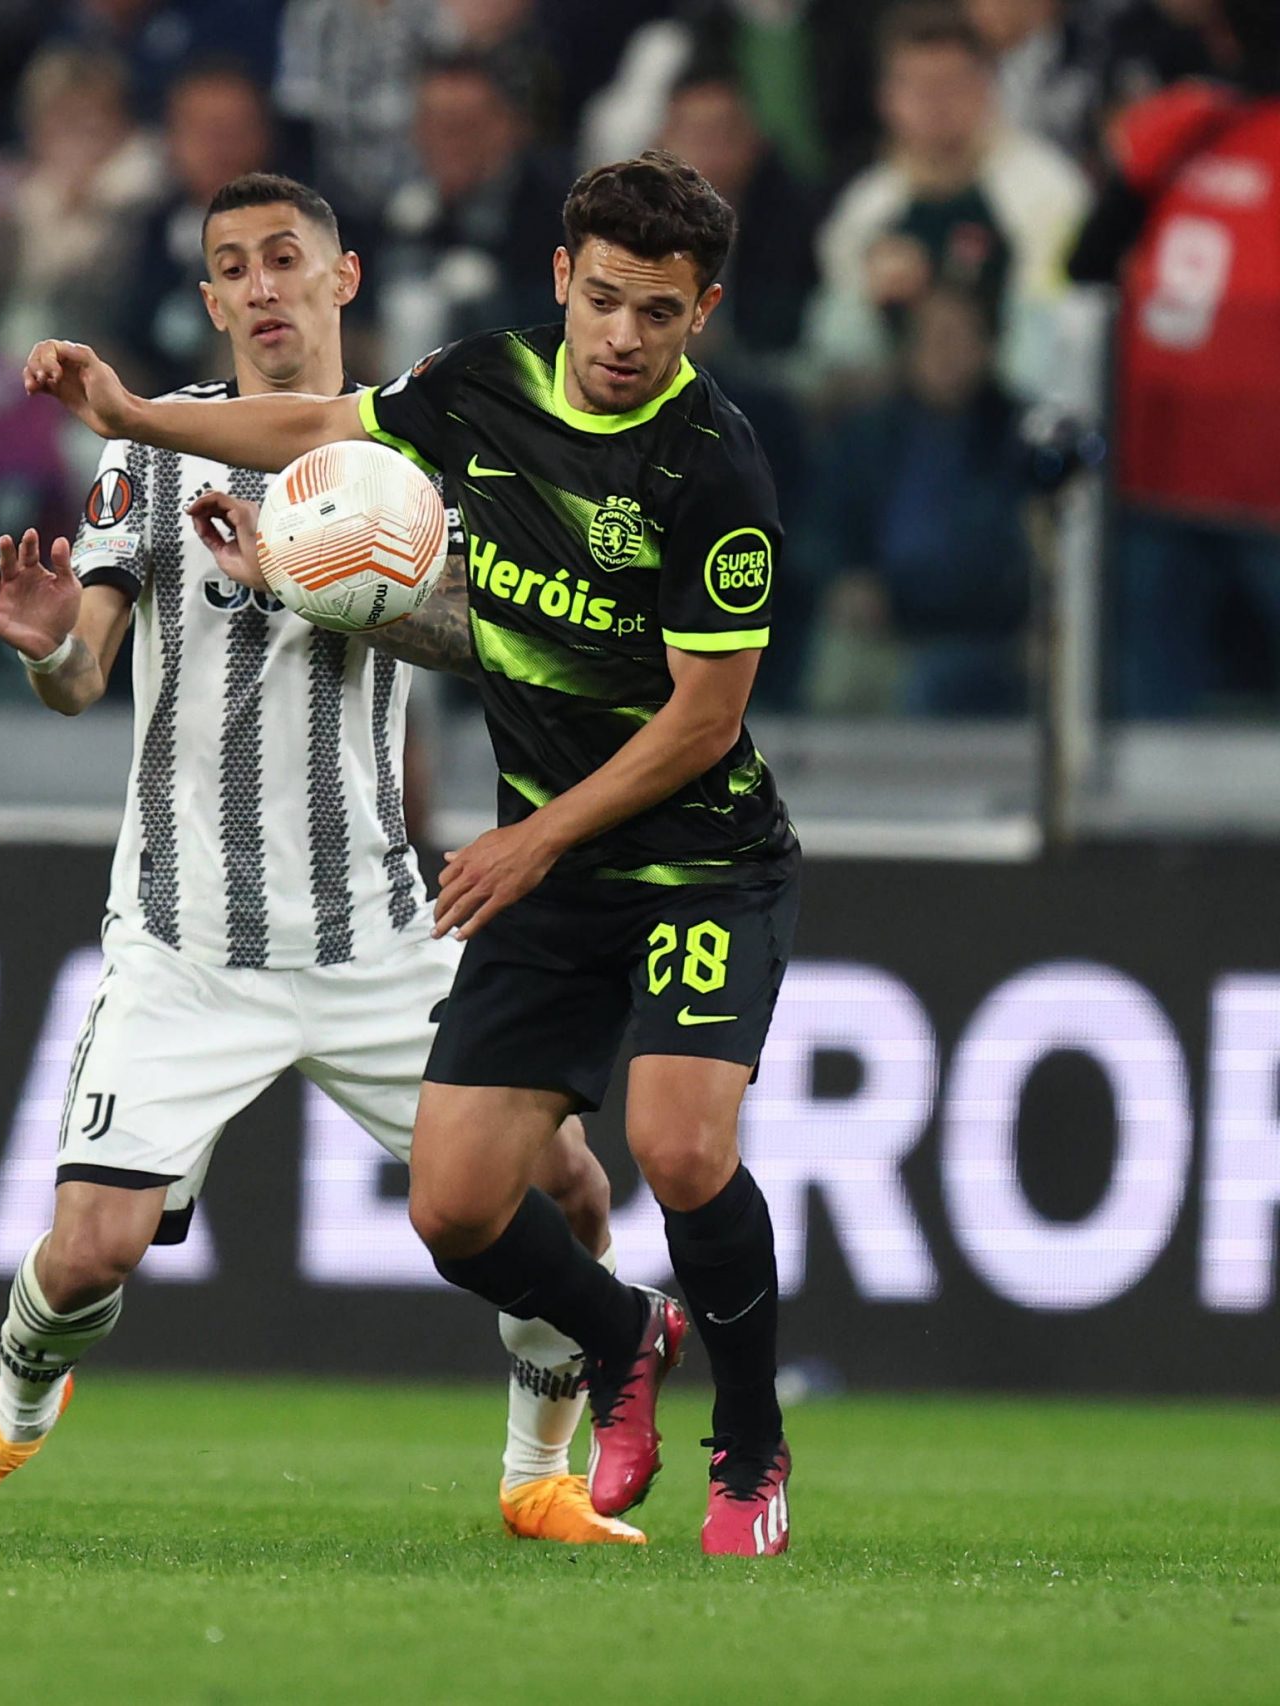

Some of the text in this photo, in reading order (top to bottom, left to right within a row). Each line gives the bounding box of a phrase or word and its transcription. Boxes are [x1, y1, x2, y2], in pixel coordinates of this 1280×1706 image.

[1143, 214, 1234, 350] 9
[606, 495, 641, 513] SCP
[597, 511, 639, 534] SPORTING
[716, 550, 766, 573] SUPER
[470, 533, 646, 637] Heróis.pt
[719, 567, 765, 590] BOCK
[364, 583, 389, 627] molten
[647, 919, 731, 996] 28
